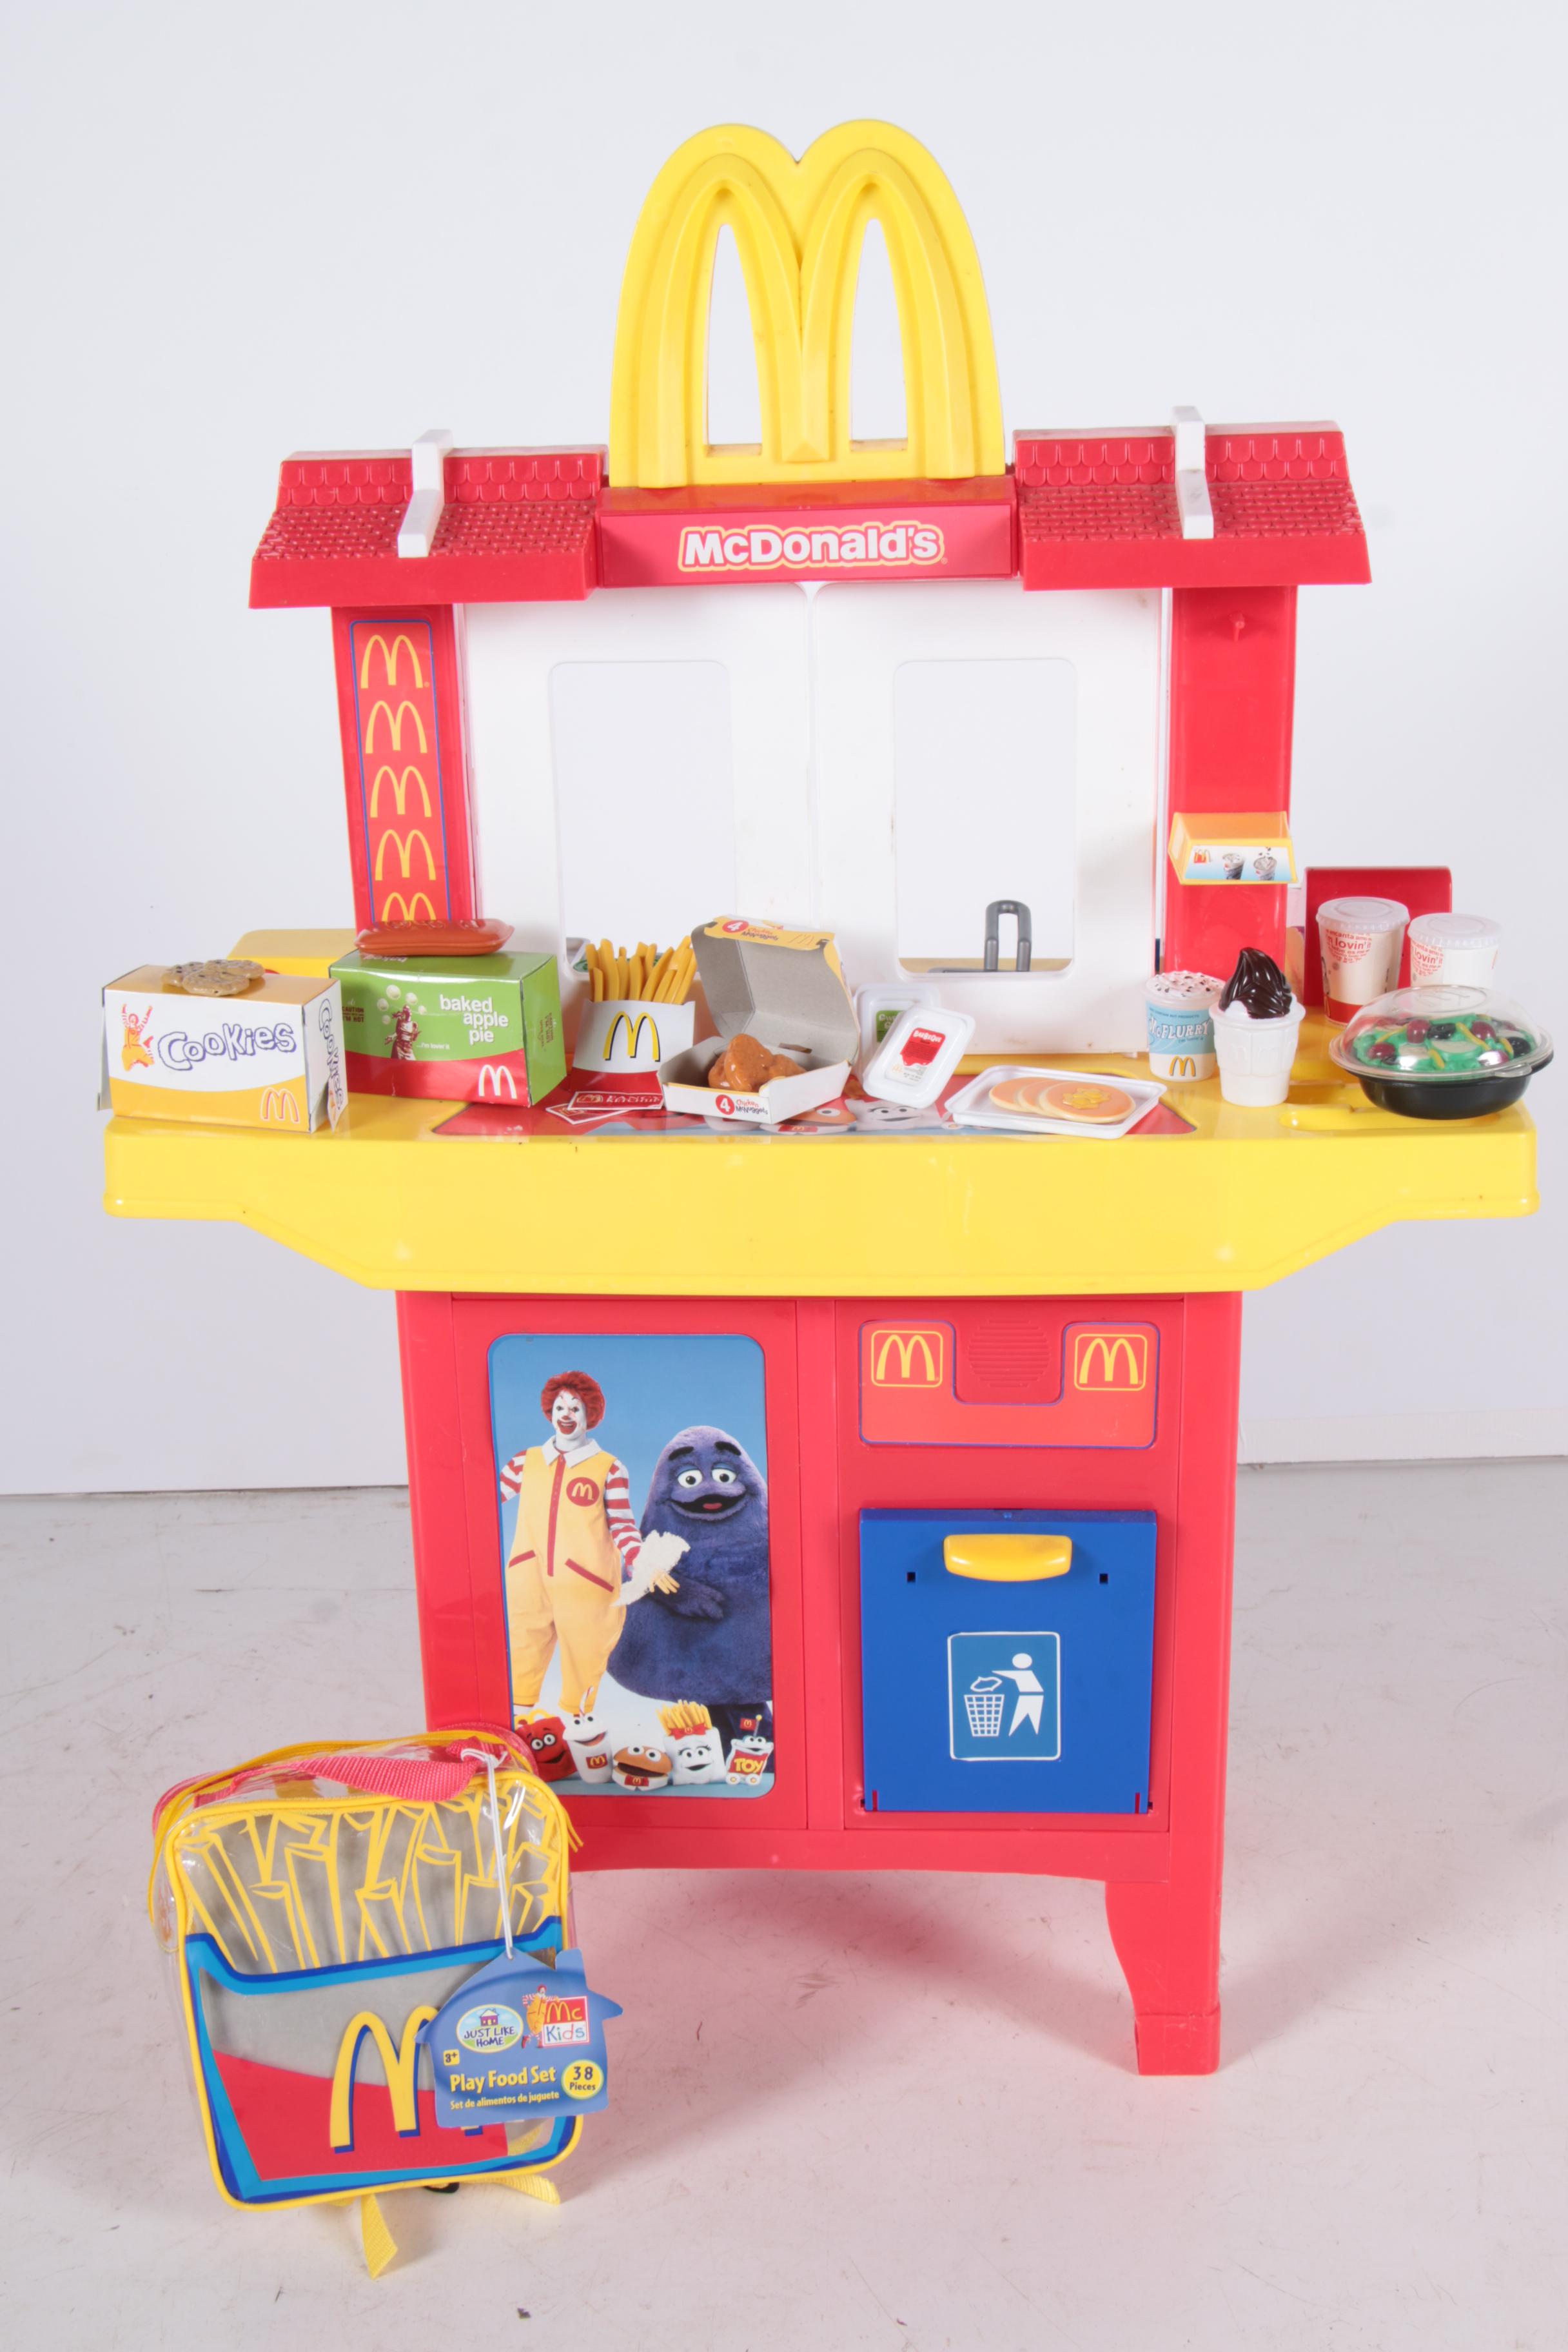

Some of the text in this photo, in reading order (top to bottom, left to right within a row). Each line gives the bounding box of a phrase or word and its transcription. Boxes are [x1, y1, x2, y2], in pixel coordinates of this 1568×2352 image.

[609, 119, 1006, 488] M
[682, 524, 940, 568] McDonald's
[361, 634, 423, 689] M
[366, 701, 427, 754] M
[370, 766, 431, 818] M
[375, 829, 436, 881] M
[727, 921, 743, 932] 4
[1335, 937, 1366, 950] lovin'
[1414, 947, 1438, 964] lovin'
[440, 994, 493, 1013] baked
[464, 1012, 509, 1030] apple
[469, 1027, 495, 1046] pie
[603, 1010, 661, 1062] M
[158, 1023, 297, 1071] Cookies
[1169, 1055, 1196, 1077] M
[478, 1064, 518, 1099] M
[260, 1087, 299, 1123] M
[720, 1097, 730, 1113] 4
[736, 1099, 760, 1108] Chicken
[736, 1106, 769, 1115] McNuggets
[876, 1334, 935, 1381] M
[1079, 1338, 1139, 1385] M
[572, 1482, 593, 1500] M
[734, 1758, 764, 1774] TOY
[547, 2001, 583, 2023] Mc
[464, 2026, 514, 2039] JUST LIKE
[546, 2024, 585, 2042] Kids
[476, 2037, 505, 2048] HOME
[445, 2052, 457, 2063] 3+
[450, 2065, 556, 2093] Play Food Set
[569, 2082, 596, 2091] Pieces
[450, 2091, 560, 2110] Set de alimentos de juguete
